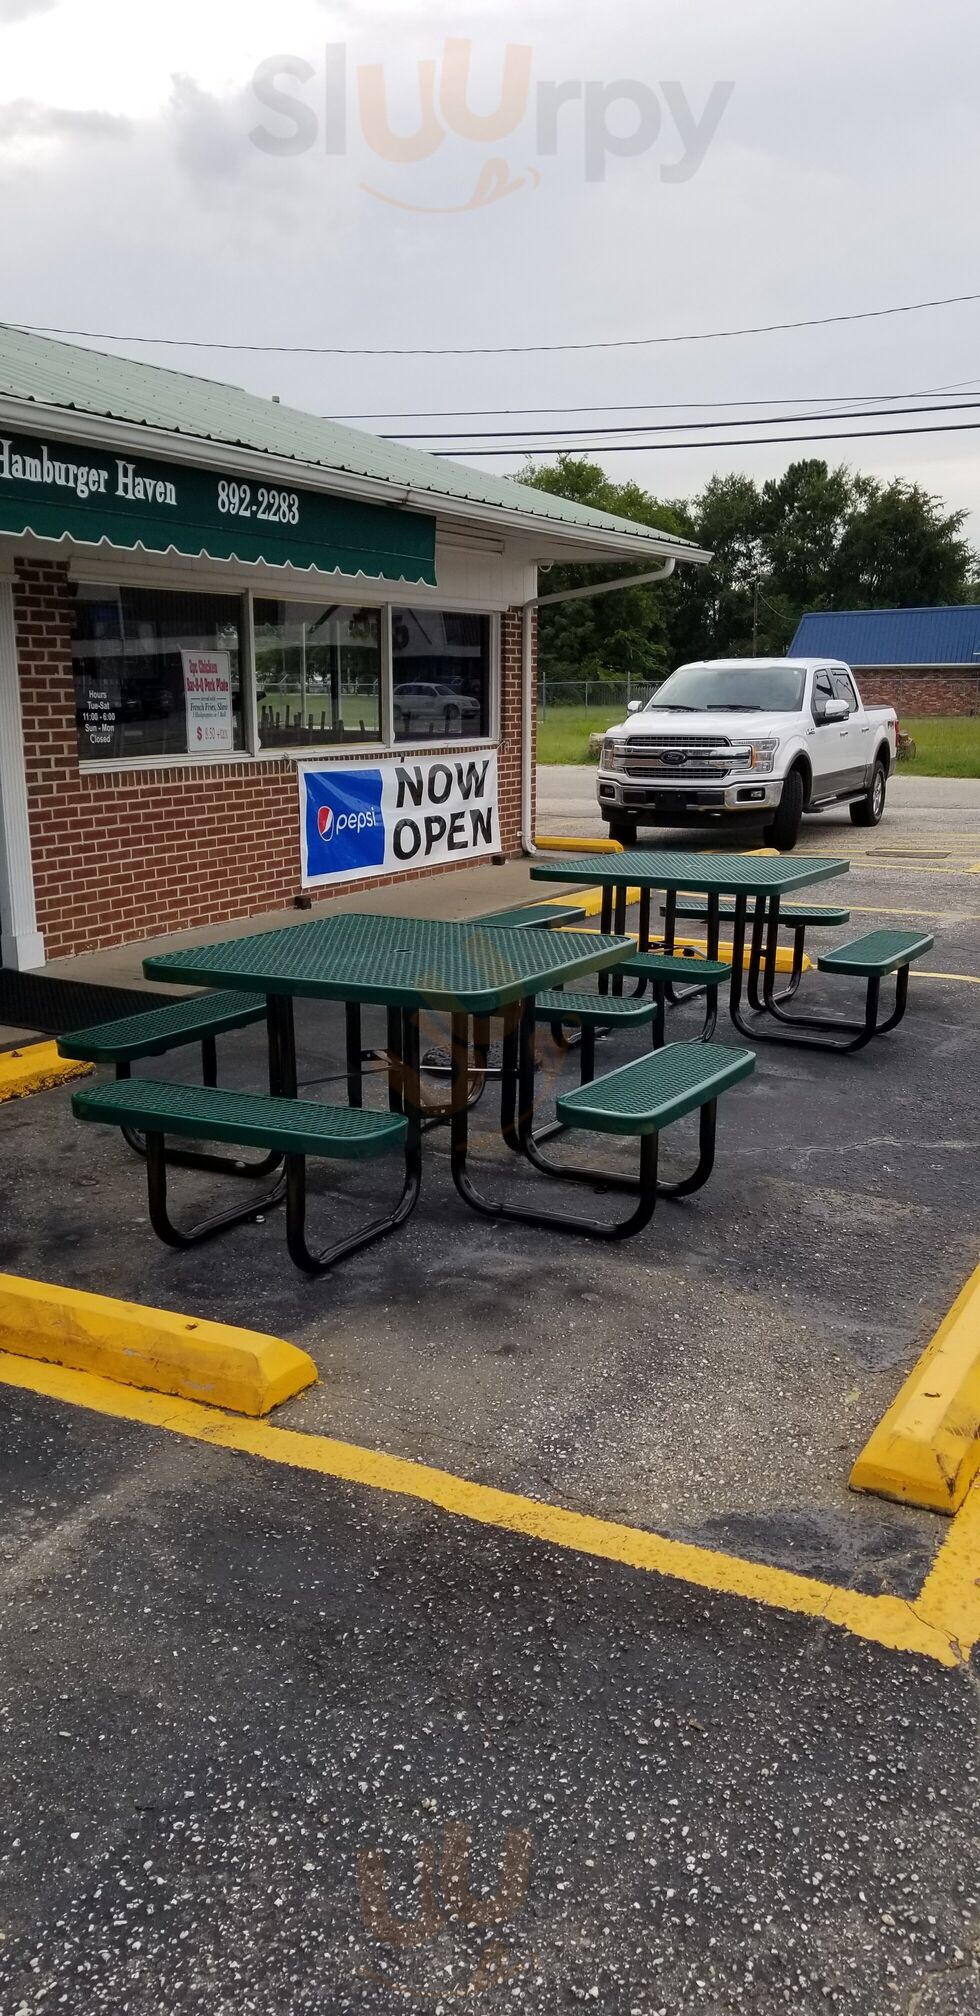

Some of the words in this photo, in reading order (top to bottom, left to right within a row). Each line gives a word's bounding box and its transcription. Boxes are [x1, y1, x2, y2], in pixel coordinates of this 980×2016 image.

[0, 439, 108, 498] Hamburger
[115, 460, 177, 506] Haven
[217, 480, 299, 525] 892-2283
[89, 690, 107, 699] Hours
[88, 701, 110, 710] Tue-Sat
[85, 724, 97, 732] Sun
[102, 724, 115, 732] Mon
[90, 734, 111, 744] Closed
[394, 760, 490, 808] NOW
[336, 807, 376, 835] pepsi
[392, 807, 492, 860] OPEN
